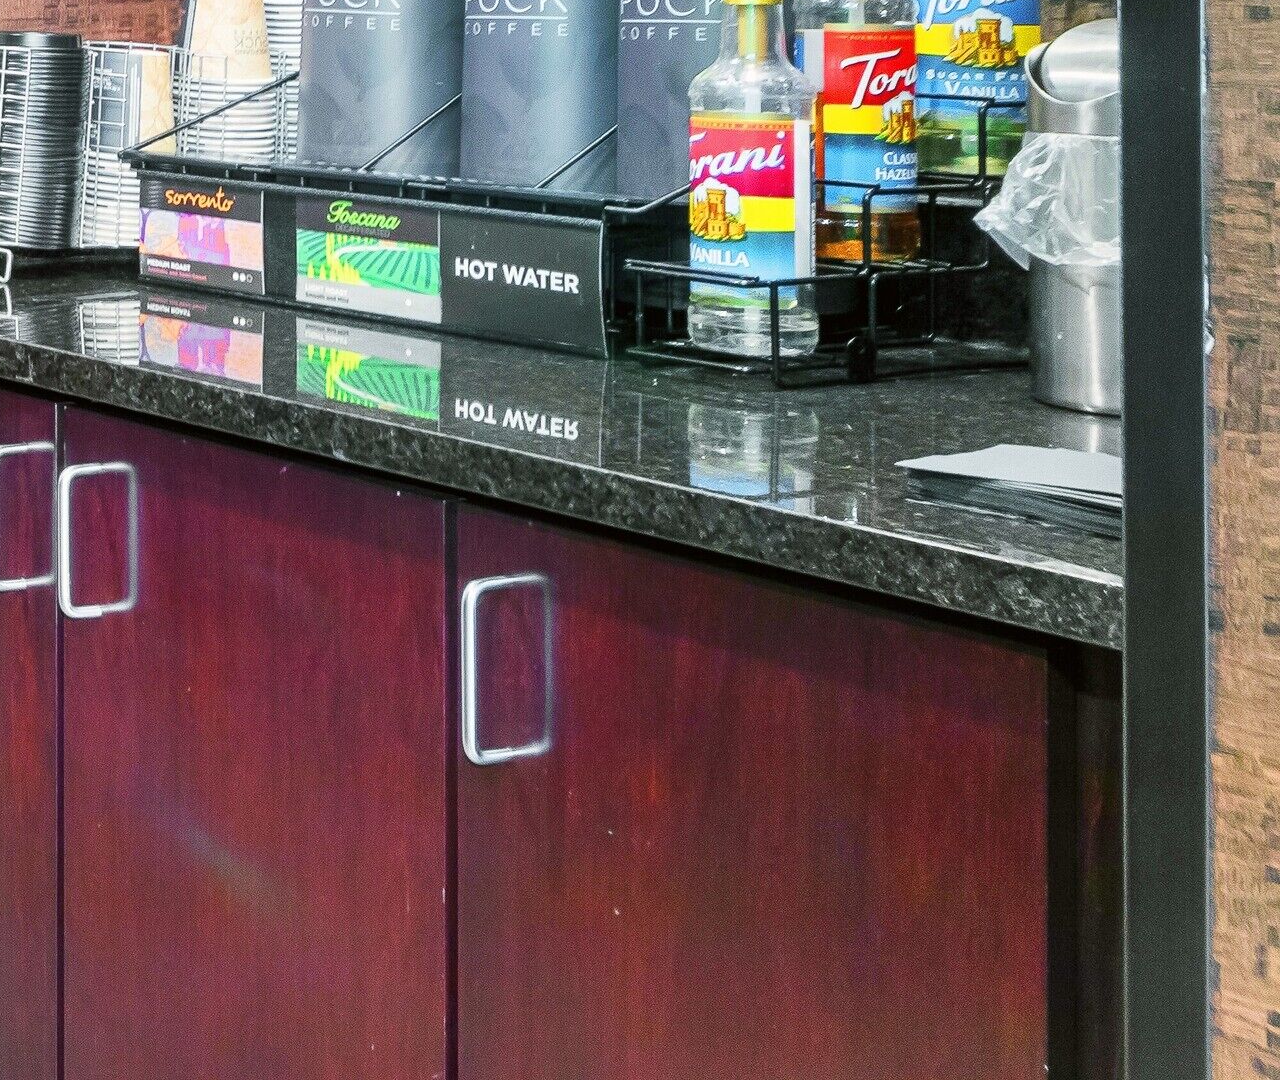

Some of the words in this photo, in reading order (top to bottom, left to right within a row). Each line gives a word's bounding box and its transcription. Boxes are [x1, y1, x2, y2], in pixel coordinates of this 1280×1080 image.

[303, 14, 401, 31] COFFEE
[464, 22, 569, 37] COFFEE
[925, 68, 985, 81] SUGAR
[944, 80, 1020, 100] VANILLA
[326, 199, 401, 231] Toscana
[690, 242, 750, 268] VANILLA
[454, 256, 498, 281] HOT
[502, 263, 579, 294] WATER
